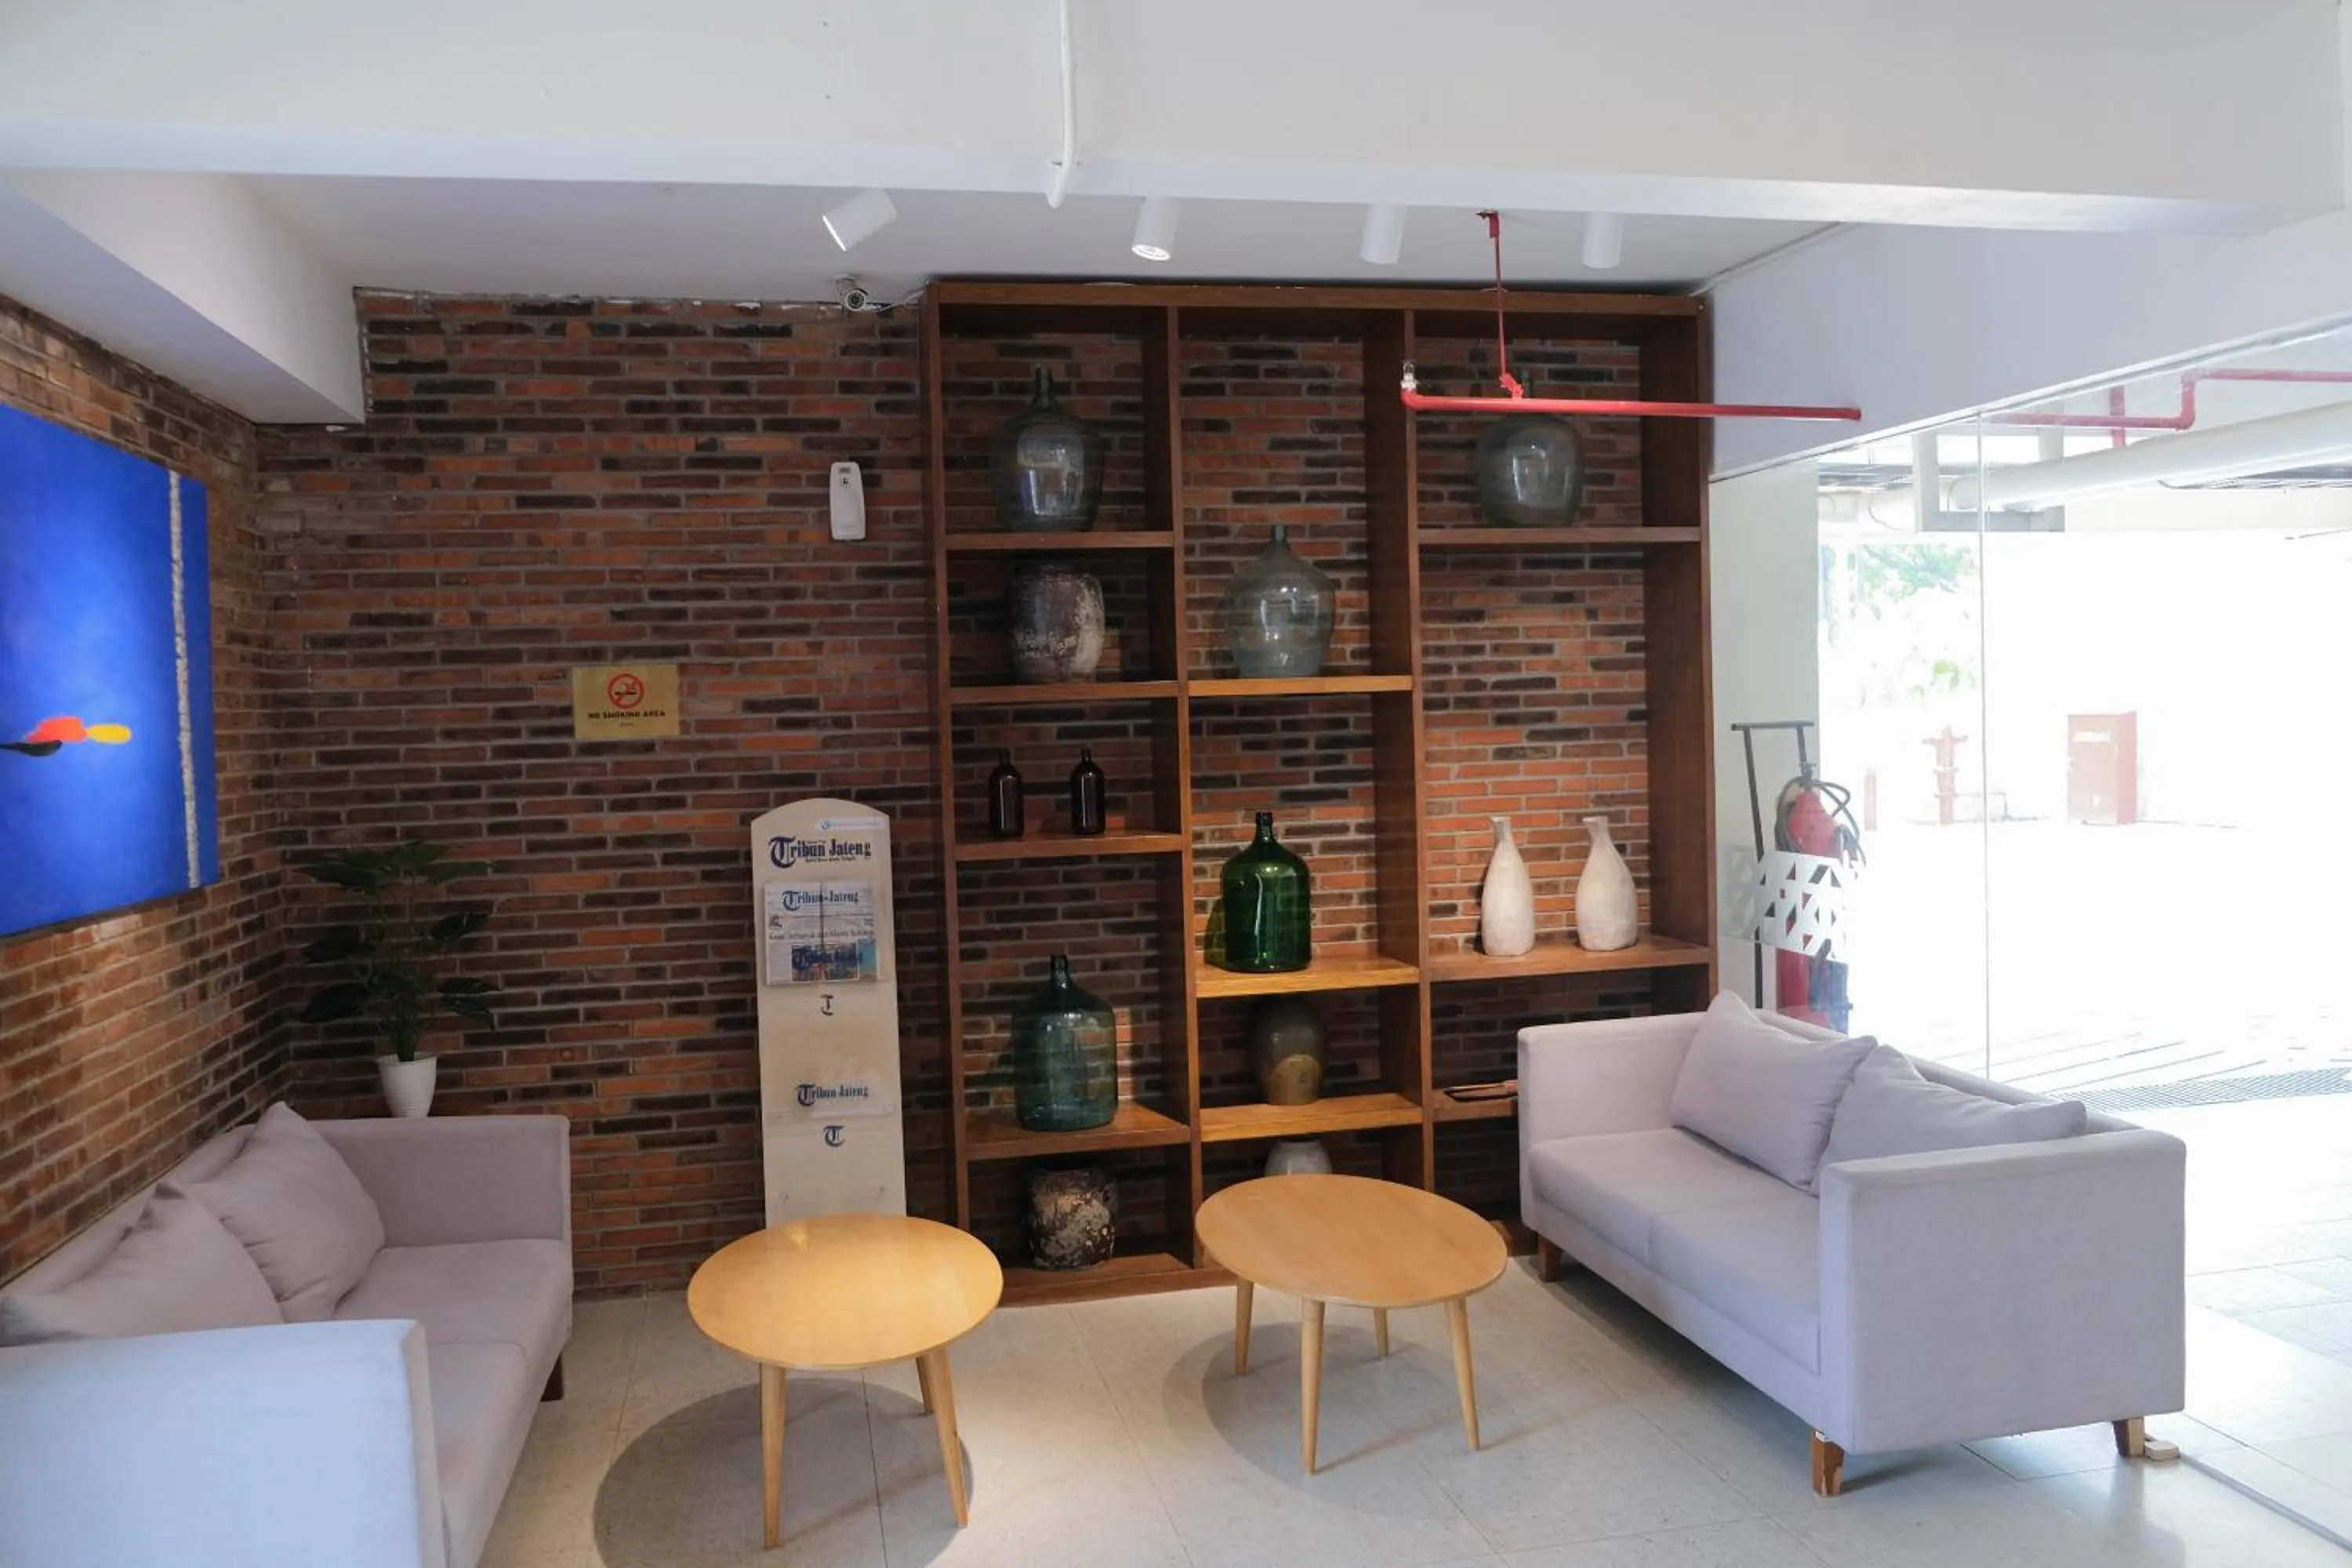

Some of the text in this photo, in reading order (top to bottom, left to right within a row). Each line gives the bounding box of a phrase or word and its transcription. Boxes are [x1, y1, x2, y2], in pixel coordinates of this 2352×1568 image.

[601, 710, 641, 719] SMOKING
[768, 836, 872, 869] Tribun Jateng
[796, 1083, 869, 1107] Tribun Jateng
[822, 1125, 847, 1148] T
